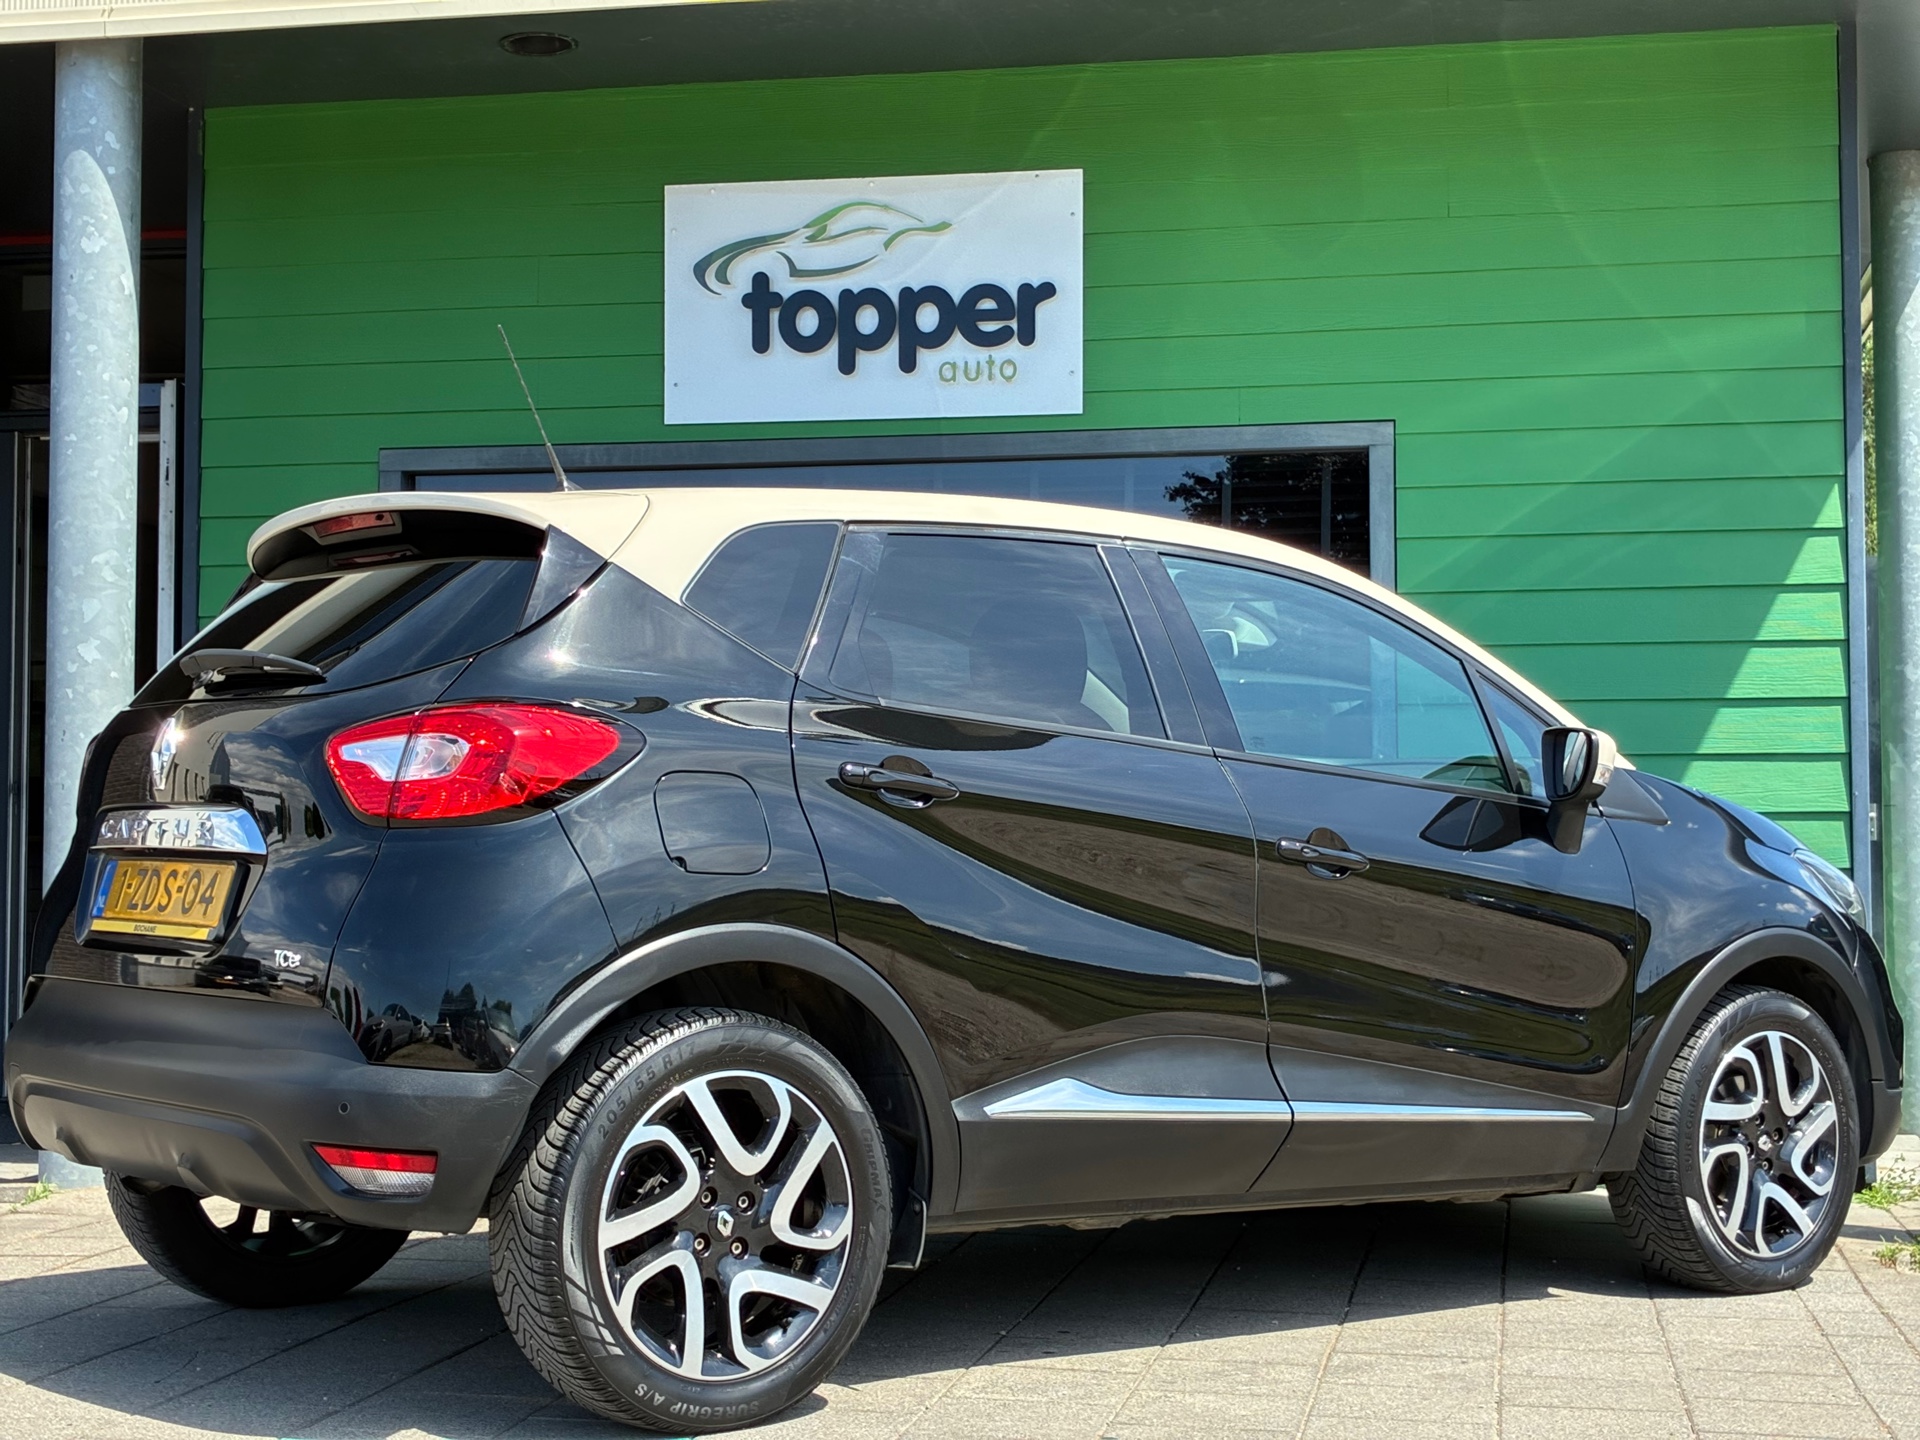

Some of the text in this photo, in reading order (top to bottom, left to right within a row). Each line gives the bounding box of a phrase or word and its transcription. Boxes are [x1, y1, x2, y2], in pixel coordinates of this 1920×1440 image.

[741, 272, 1057, 375] topper
[938, 355, 1018, 383] auto
[101, 818, 212, 840] CAPTUR
[115, 868, 219, 917] 1-ZDS-04
[133, 922, 157, 934] BOCHANE
[274, 949, 302, 968] TCe
[598, 1068, 656, 1140] 205/55
[662, 1040, 697, 1070] R17
[634, 1383, 666, 1406] A/S
[669, 1401, 759, 1420] SUREGRIP
